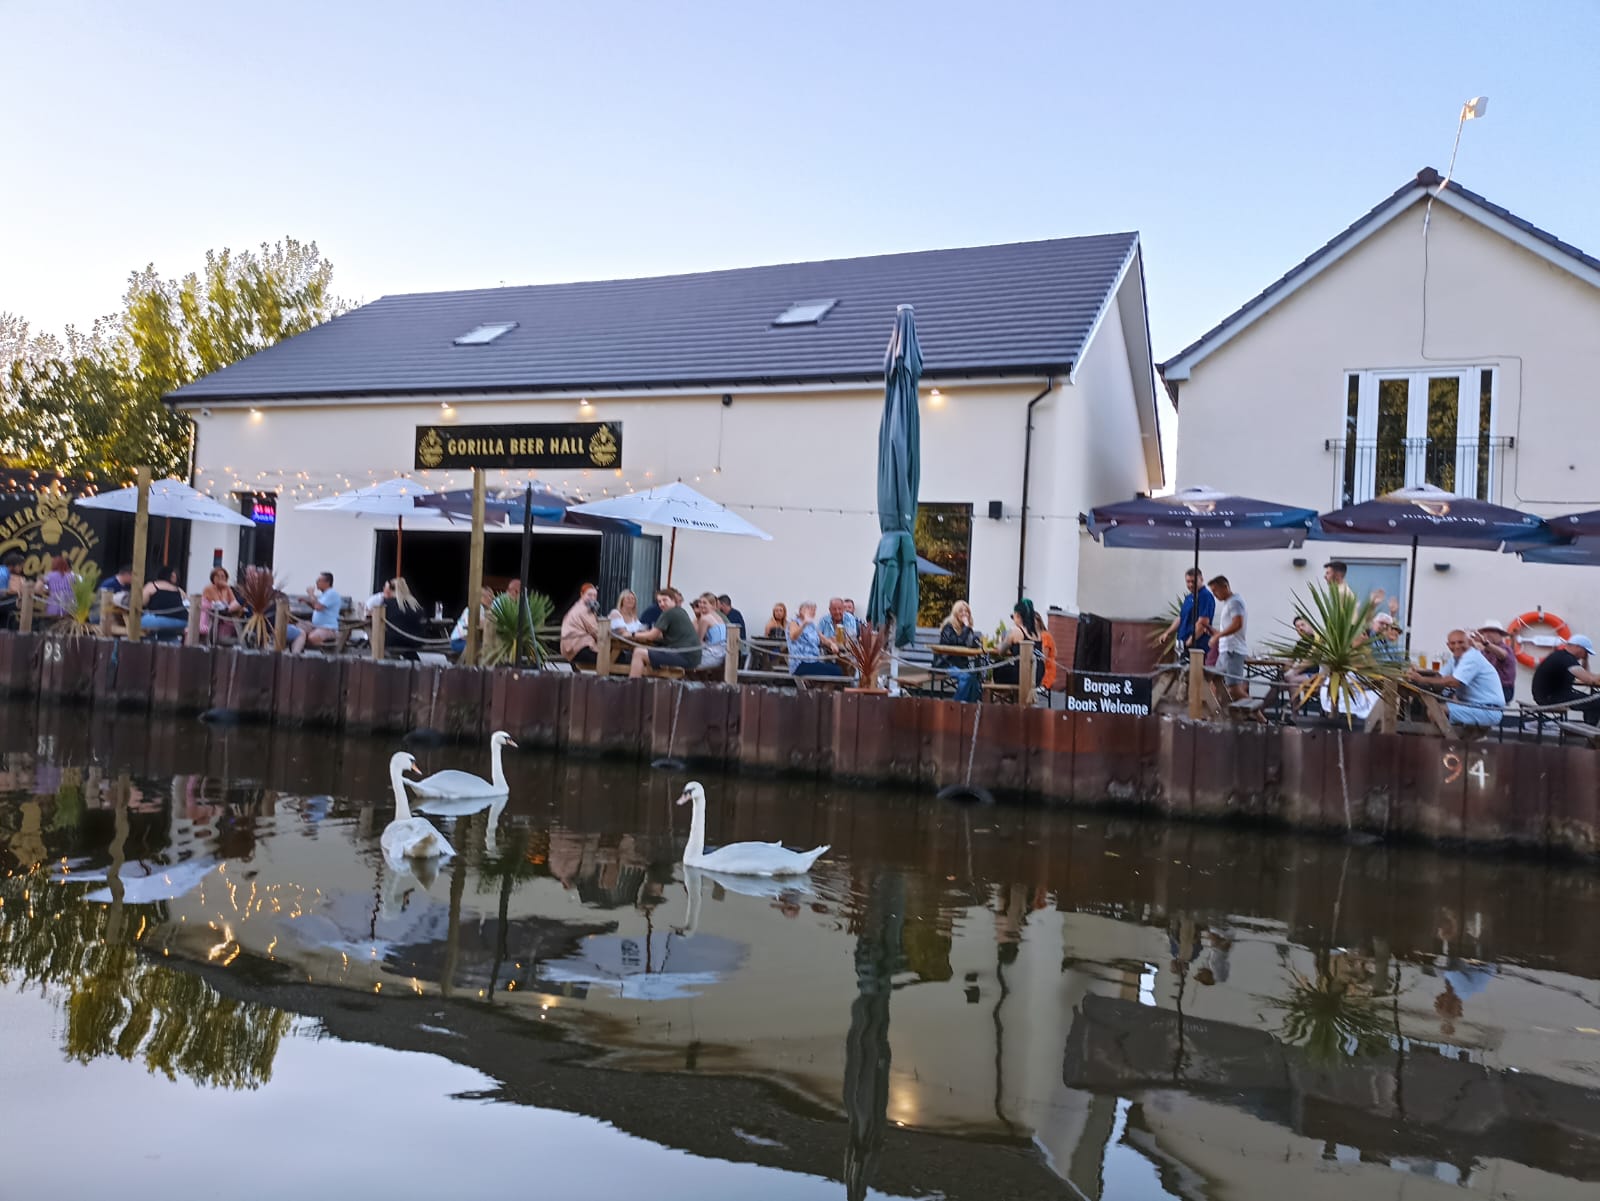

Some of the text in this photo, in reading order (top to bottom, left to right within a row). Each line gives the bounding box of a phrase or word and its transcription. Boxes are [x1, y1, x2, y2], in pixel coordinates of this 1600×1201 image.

[448, 437, 585, 455] GORILLA BEER HALL
[0, 507, 99, 549] BEER HALL
[44, 641, 62, 662] 93
[1083, 677, 1134, 697] Barges &
[1067, 696, 1149, 715] Boats Welcome
